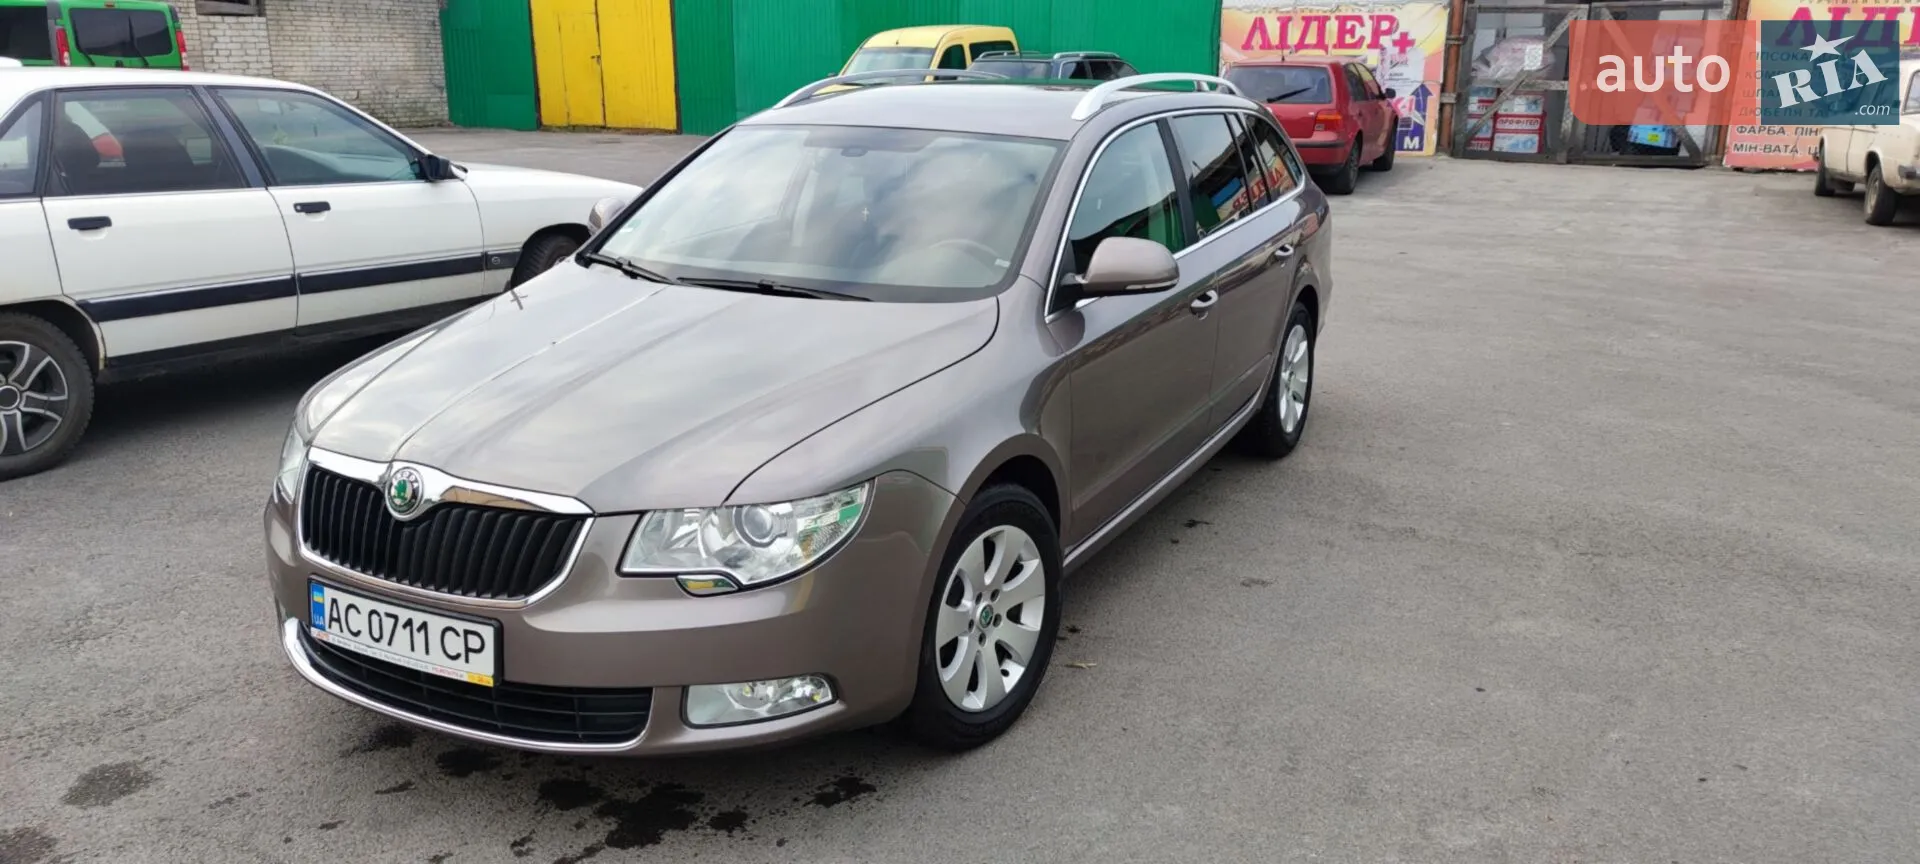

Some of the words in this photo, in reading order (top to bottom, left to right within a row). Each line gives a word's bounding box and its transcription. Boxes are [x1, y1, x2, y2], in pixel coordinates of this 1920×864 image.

[328, 598, 362, 637] AC
[368, 609, 430, 656] 0711
[440, 626, 485, 664] CP
